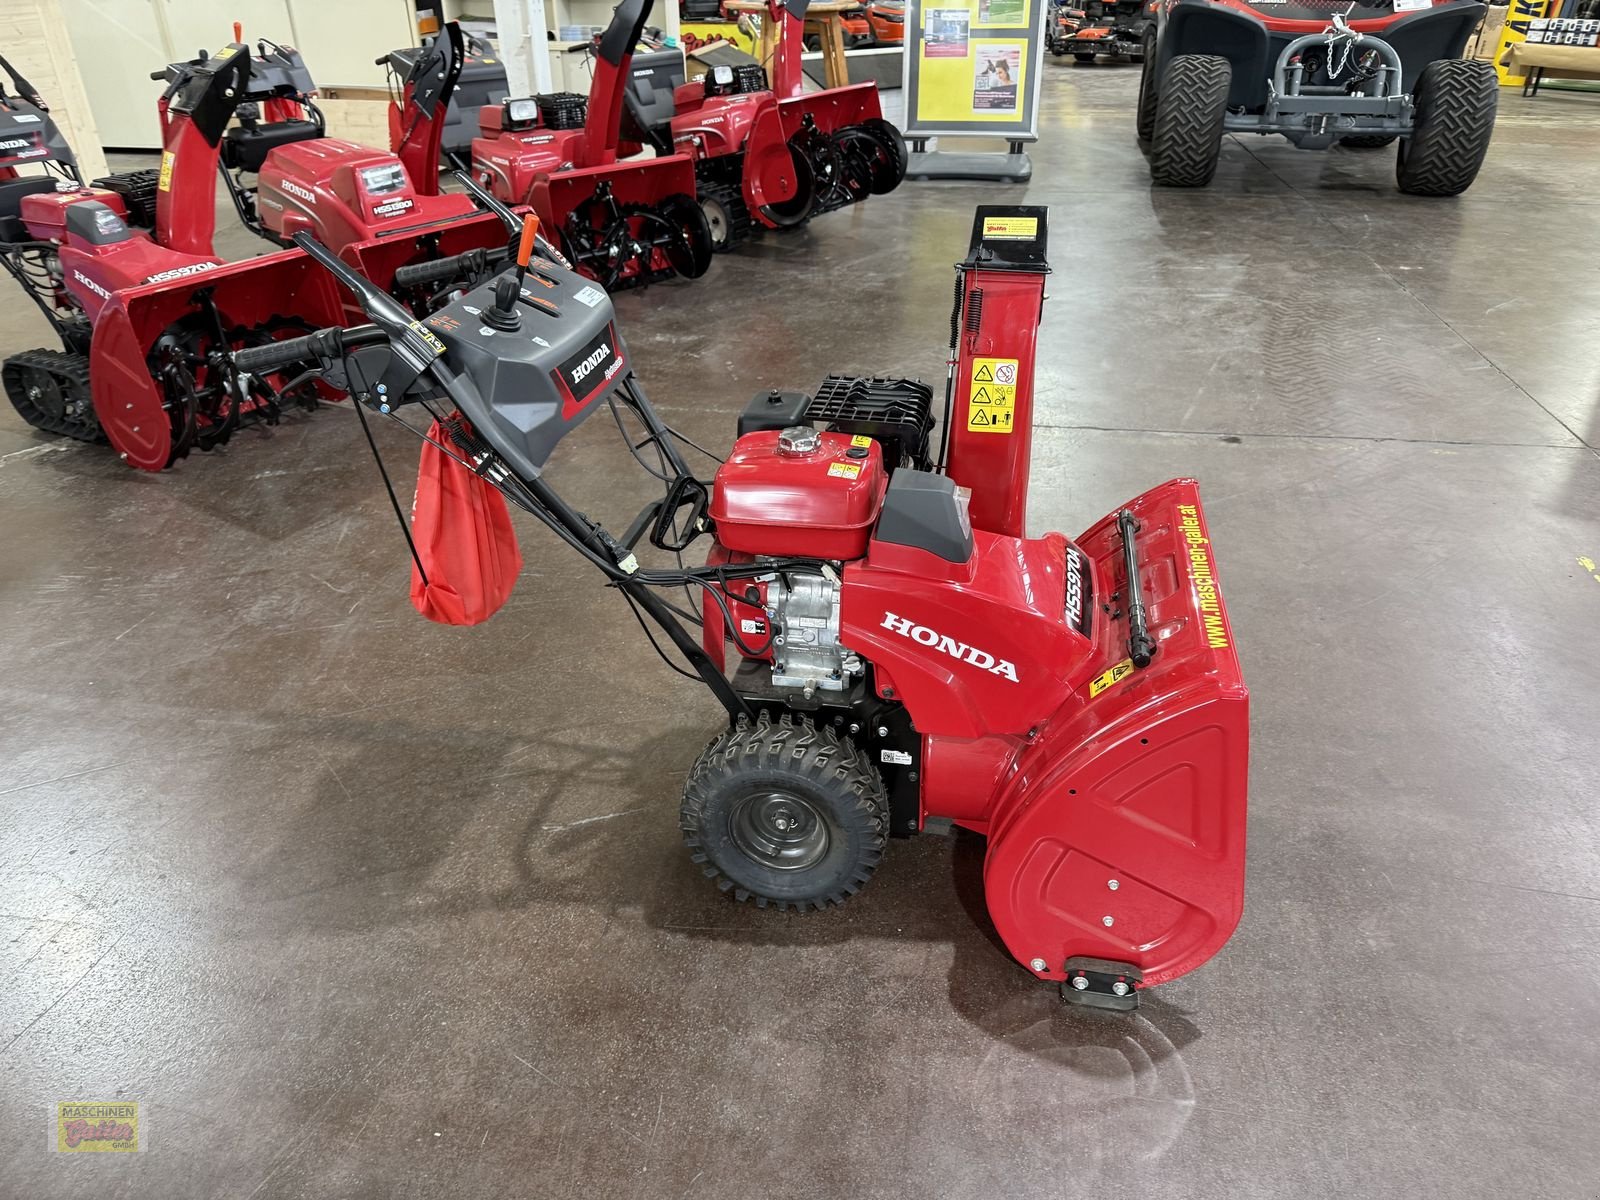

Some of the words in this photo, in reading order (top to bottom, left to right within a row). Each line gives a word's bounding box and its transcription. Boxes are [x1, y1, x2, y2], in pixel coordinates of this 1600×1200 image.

[701, 116, 724, 126] HONDA
[0, 139, 30, 150] NDA
[281, 179, 316, 204] HONDA
[147, 261, 218, 284] HSS970A
[571, 343, 611, 384] HONDA
[1065, 547, 1081, 623] HSS970A
[1177, 504, 1229, 649] www.maschinen-gailer.at
[880, 611, 1020, 683] HONDA
